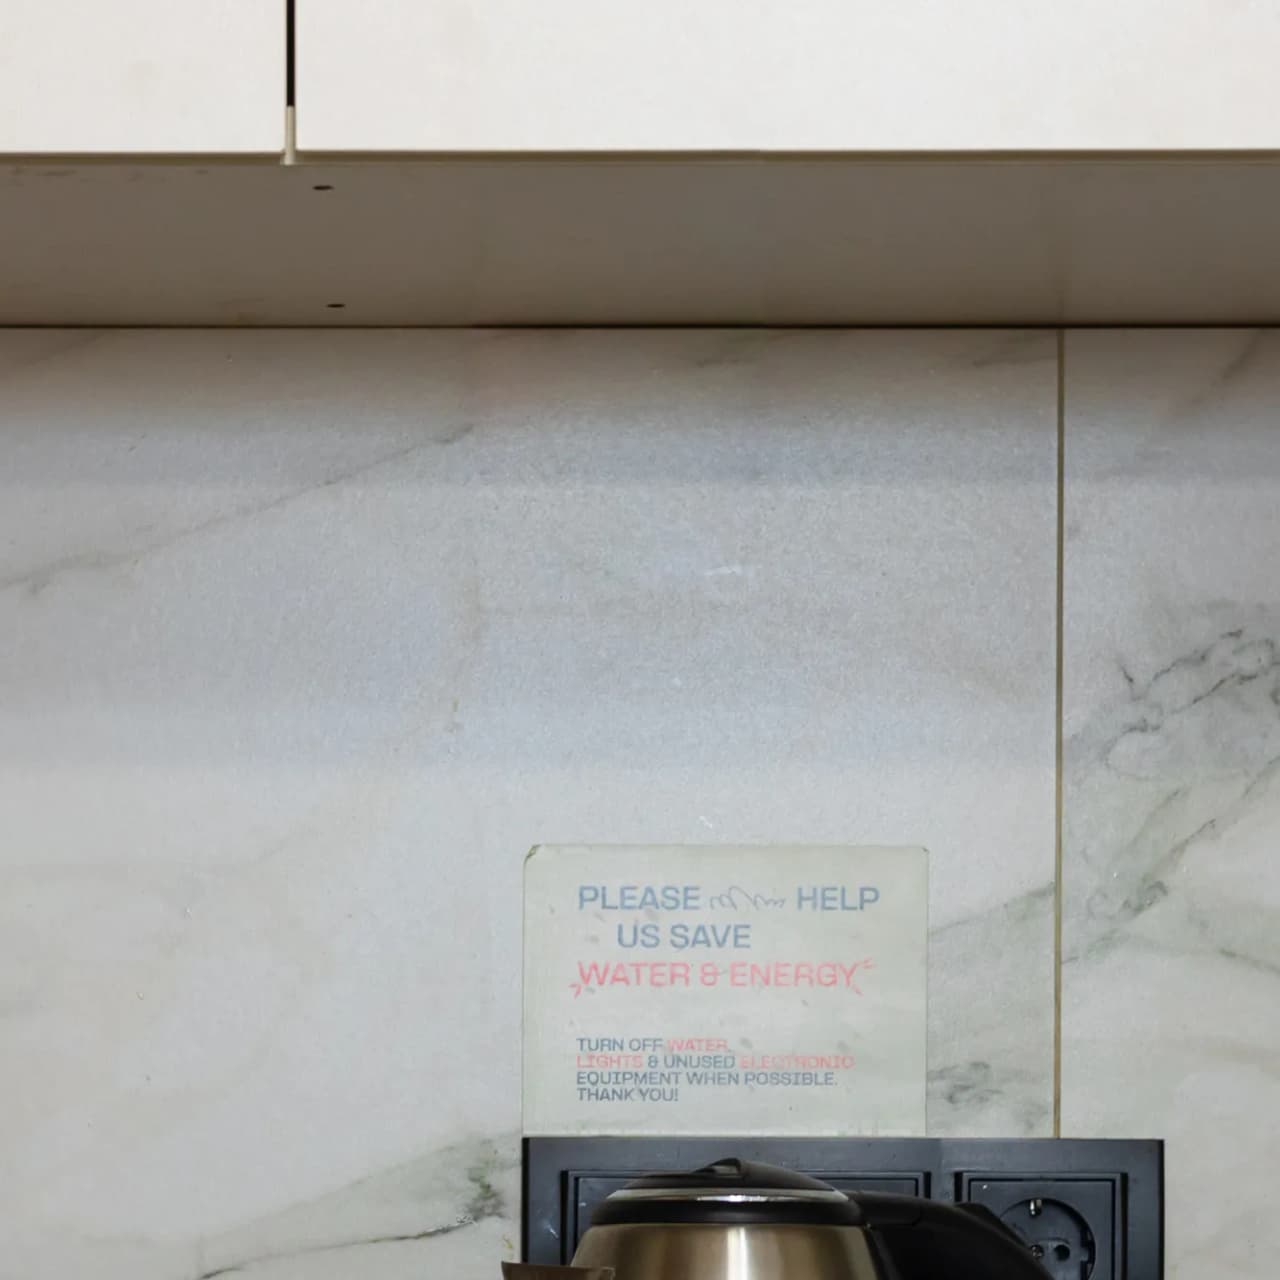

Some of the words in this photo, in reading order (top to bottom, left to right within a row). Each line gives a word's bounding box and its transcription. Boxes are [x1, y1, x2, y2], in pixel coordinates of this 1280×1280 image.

[578, 885, 701, 911] PLEASE
[796, 886, 881, 911] HELP
[617, 923, 661, 949] US
[669, 923, 752, 949] SAVE
[577, 960, 691, 988] WATER
[699, 962, 719, 988] &
[729, 961, 858, 988] ENERGY
[576, 1038, 625, 1052] TURN
[628, 1038, 665, 1052] OFF
[576, 1055, 644, 1069] LIGHTS
[647, 1055, 659, 1069] &
[663, 1055, 736, 1069] UNUSED
[738, 1055, 856, 1070] ELECTRONIC
[576, 1071, 681, 1087] EQUIPMENT
[686, 1071, 740, 1086] WHEN
[744, 1071, 839, 1087] POSSIBLE.
[576, 1088, 637, 1102] THANK
[638, 1088, 679, 1102] YOU!
